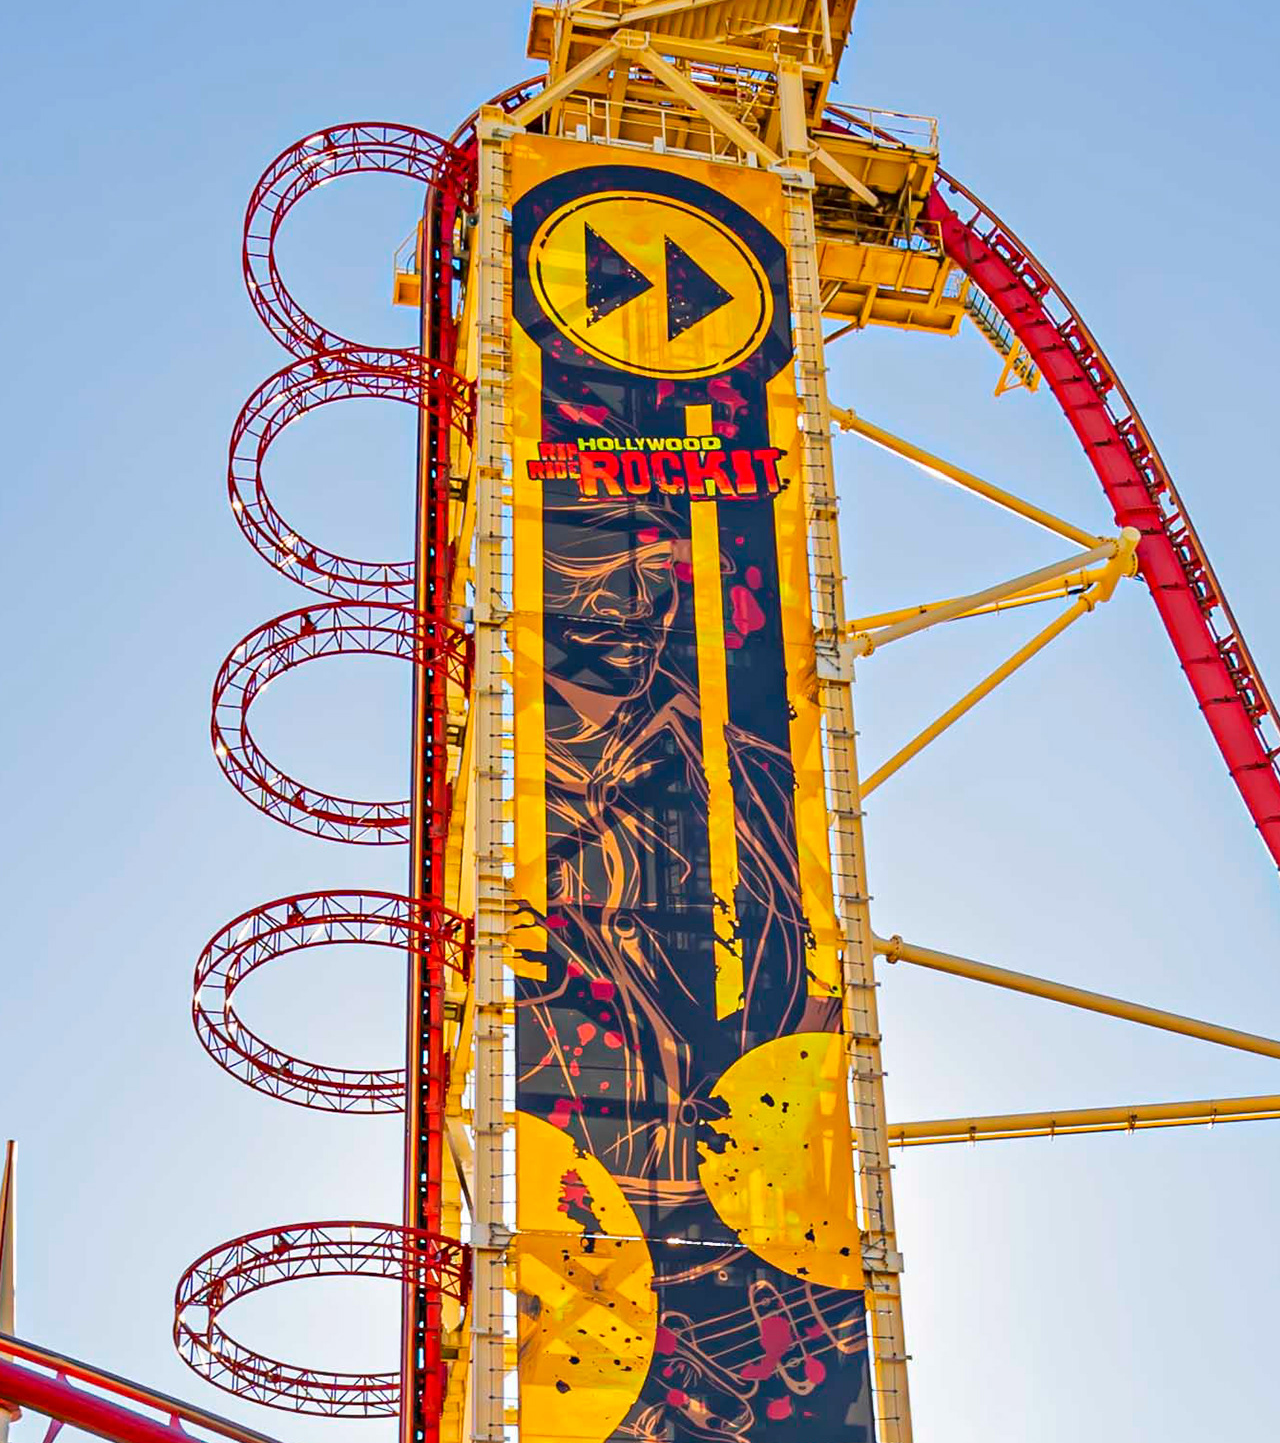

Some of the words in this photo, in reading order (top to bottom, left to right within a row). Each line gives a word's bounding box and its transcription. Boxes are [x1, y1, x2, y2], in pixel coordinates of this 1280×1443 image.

[577, 437, 722, 451] HOLLYWOOD
[528, 461, 581, 480] RIDE
[578, 450, 781, 497] ROCKIT
